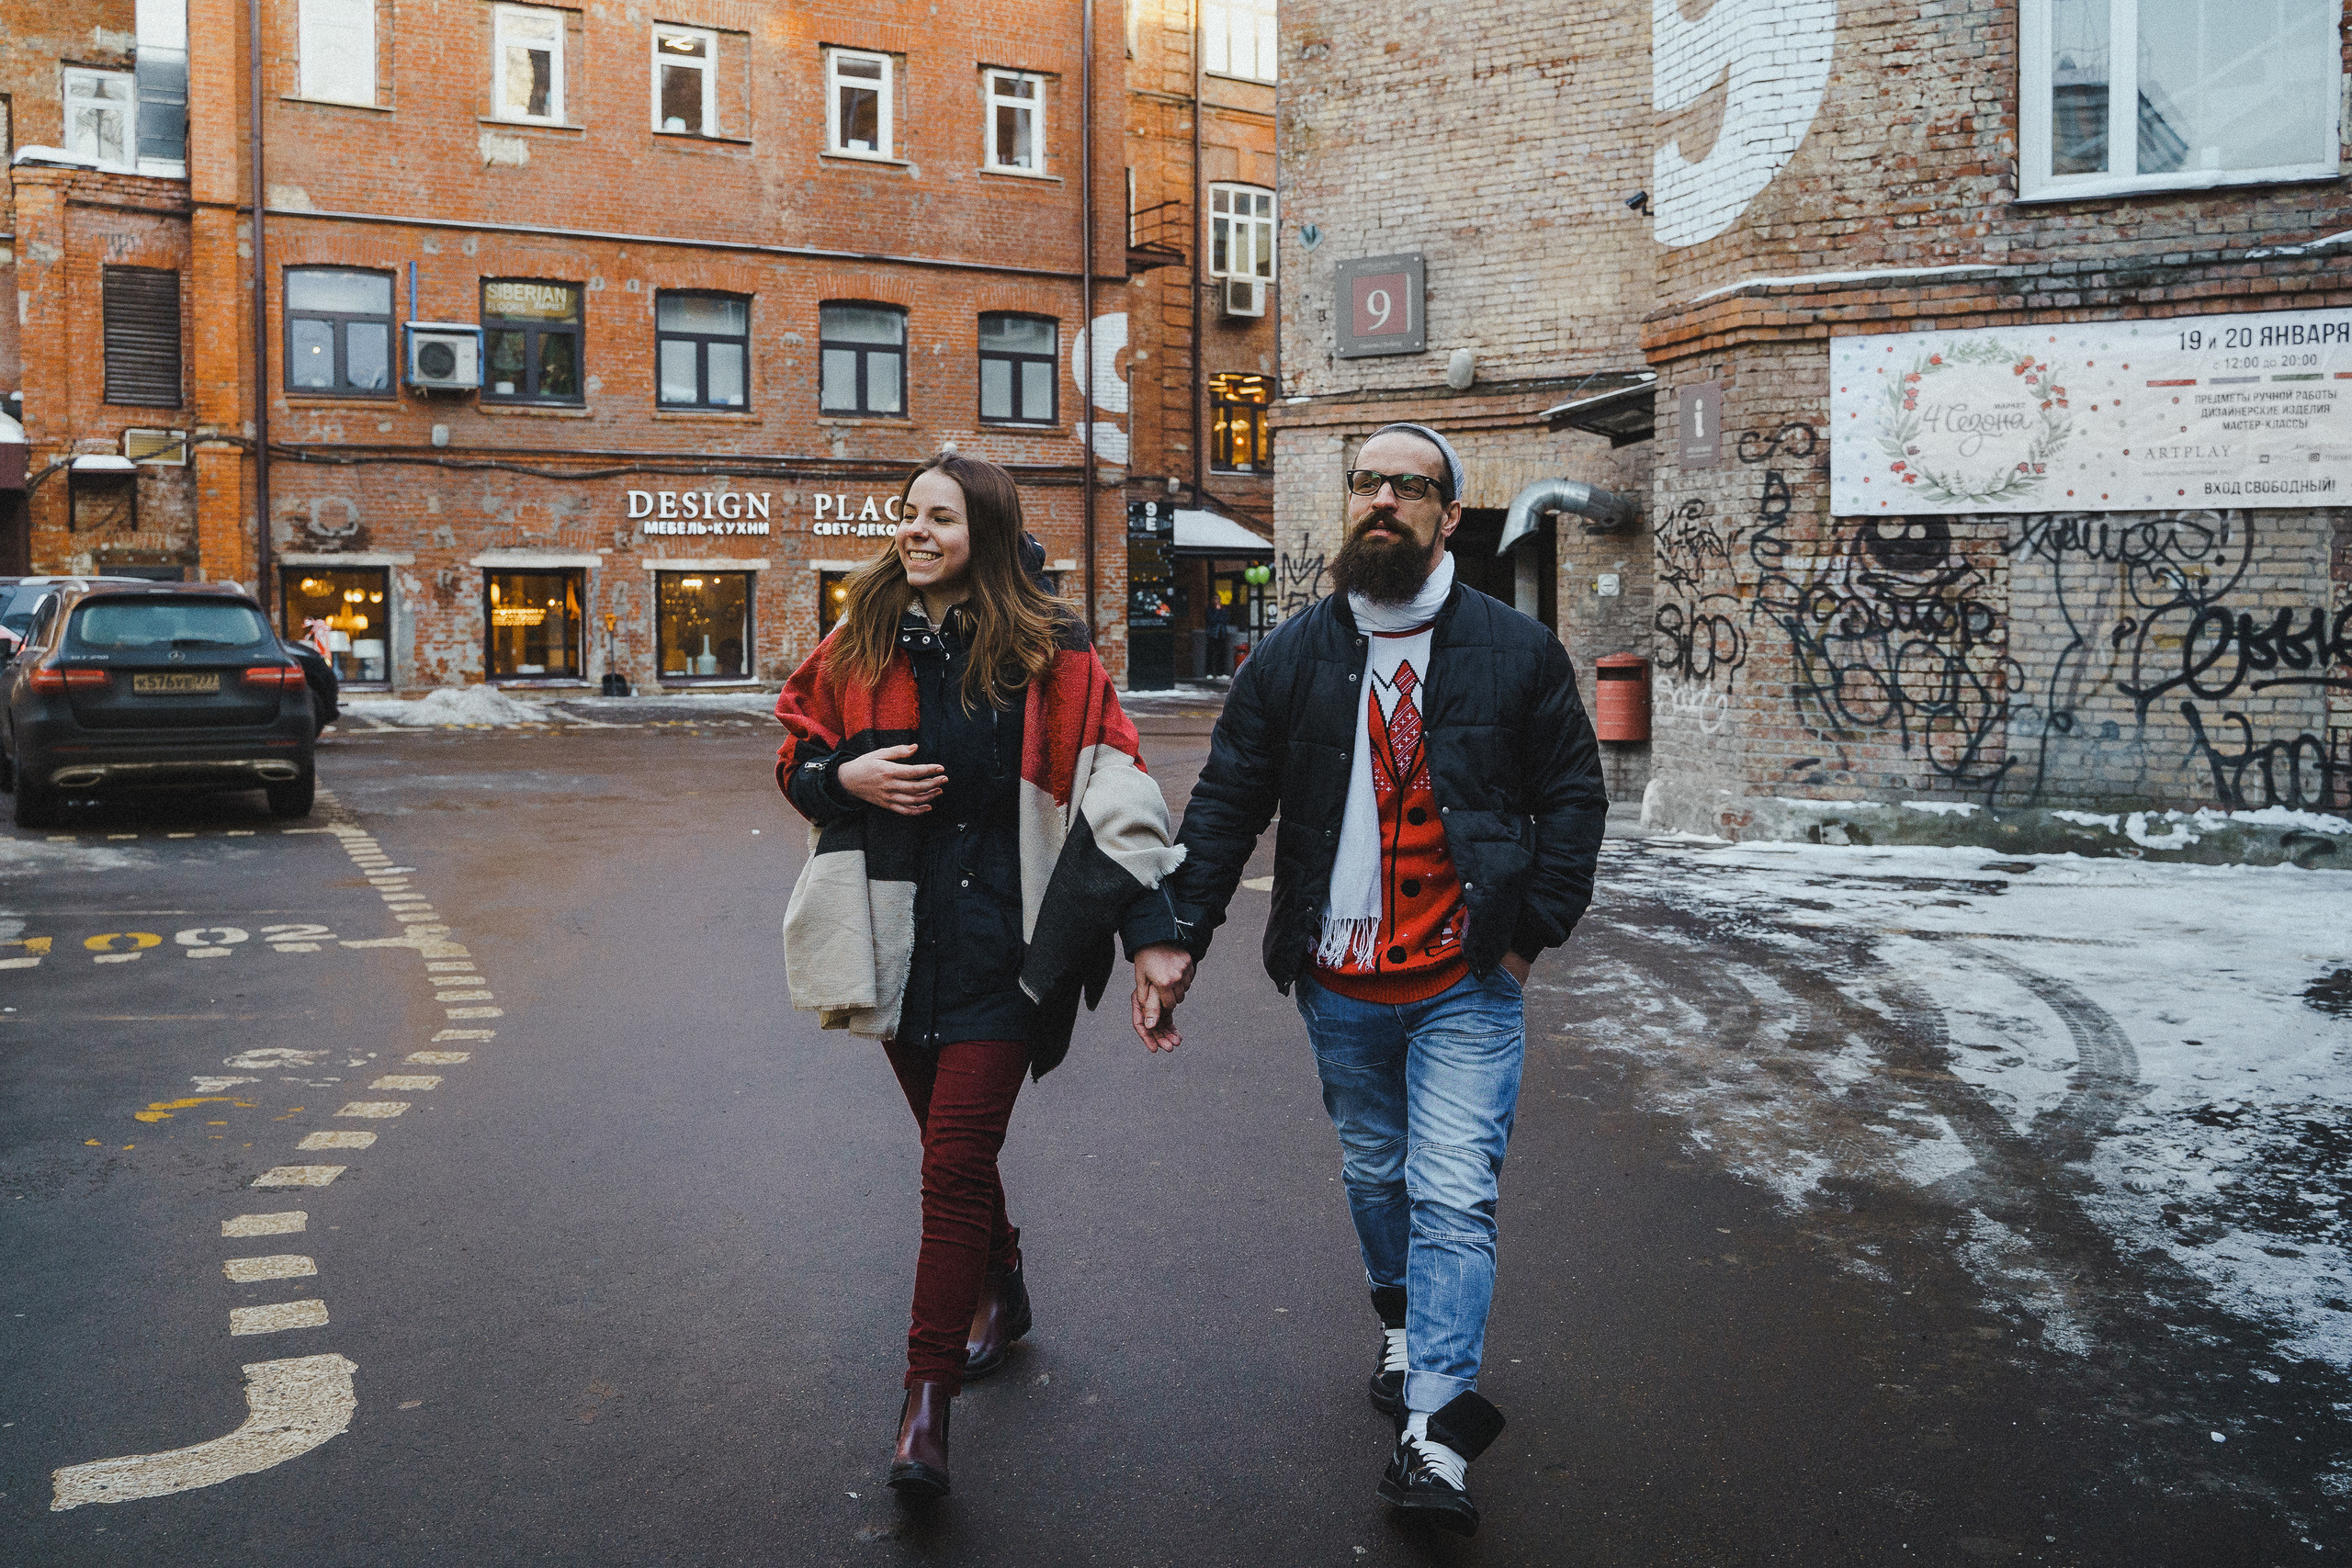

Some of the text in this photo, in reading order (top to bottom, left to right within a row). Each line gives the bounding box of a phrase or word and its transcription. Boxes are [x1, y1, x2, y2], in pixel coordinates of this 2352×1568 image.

[485, 283, 567, 303] SIBERIAN
[1366, 289, 1392, 331] 9
[2179, 321, 2351, 350] 19 и 20 ЯНВАРЯ
[2224, 356, 2259, 369] 12:00
[2281, 354, 2318, 367] 20:00
[2194, 389, 2337, 404] ПРЕДМЕТЫ РУЧНОЙ РАБОТЫ
[1923, 404, 1940, 433] 4
[2199, 404, 2331, 419] ДИЗАЙНЕРСКИЕ ИЗДЕЛИЯ
[2144, 445, 2232, 459] ARTPLAY
[2204, 477, 2336, 495] ВХОД СВОБОДНЫЙ!
[627, 490, 901, 522] DESIGN PLAC
[1145, 502, 1157, 516] 9
